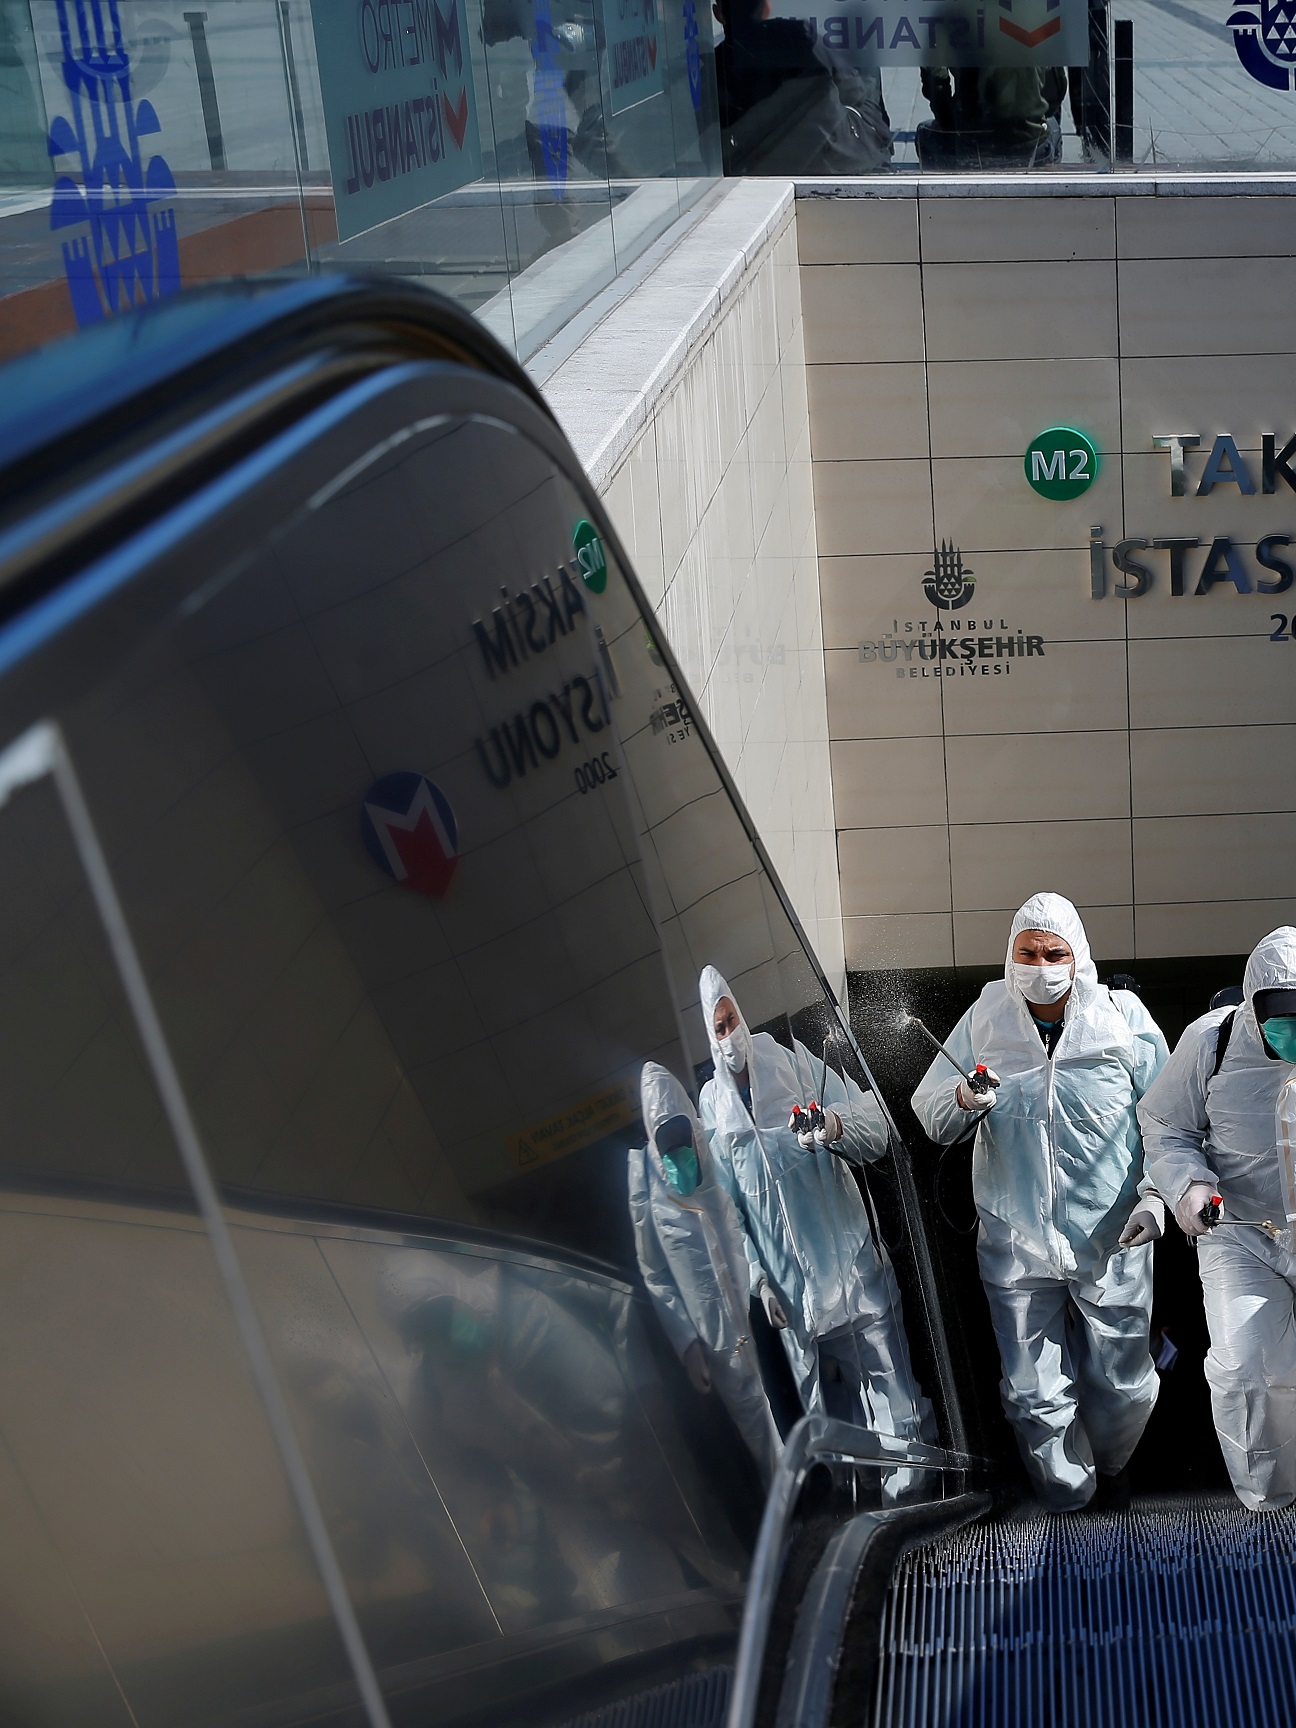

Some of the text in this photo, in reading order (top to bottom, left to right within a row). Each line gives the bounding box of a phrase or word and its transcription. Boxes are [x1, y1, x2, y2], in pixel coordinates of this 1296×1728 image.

[1031, 449, 1089, 482] M2
[892, 618, 1009, 634] İSTANBUL
[857, 628, 1046, 666] BÜYÜKŞEHİR
[895, 660, 1011, 679] BELEDİYESİ
